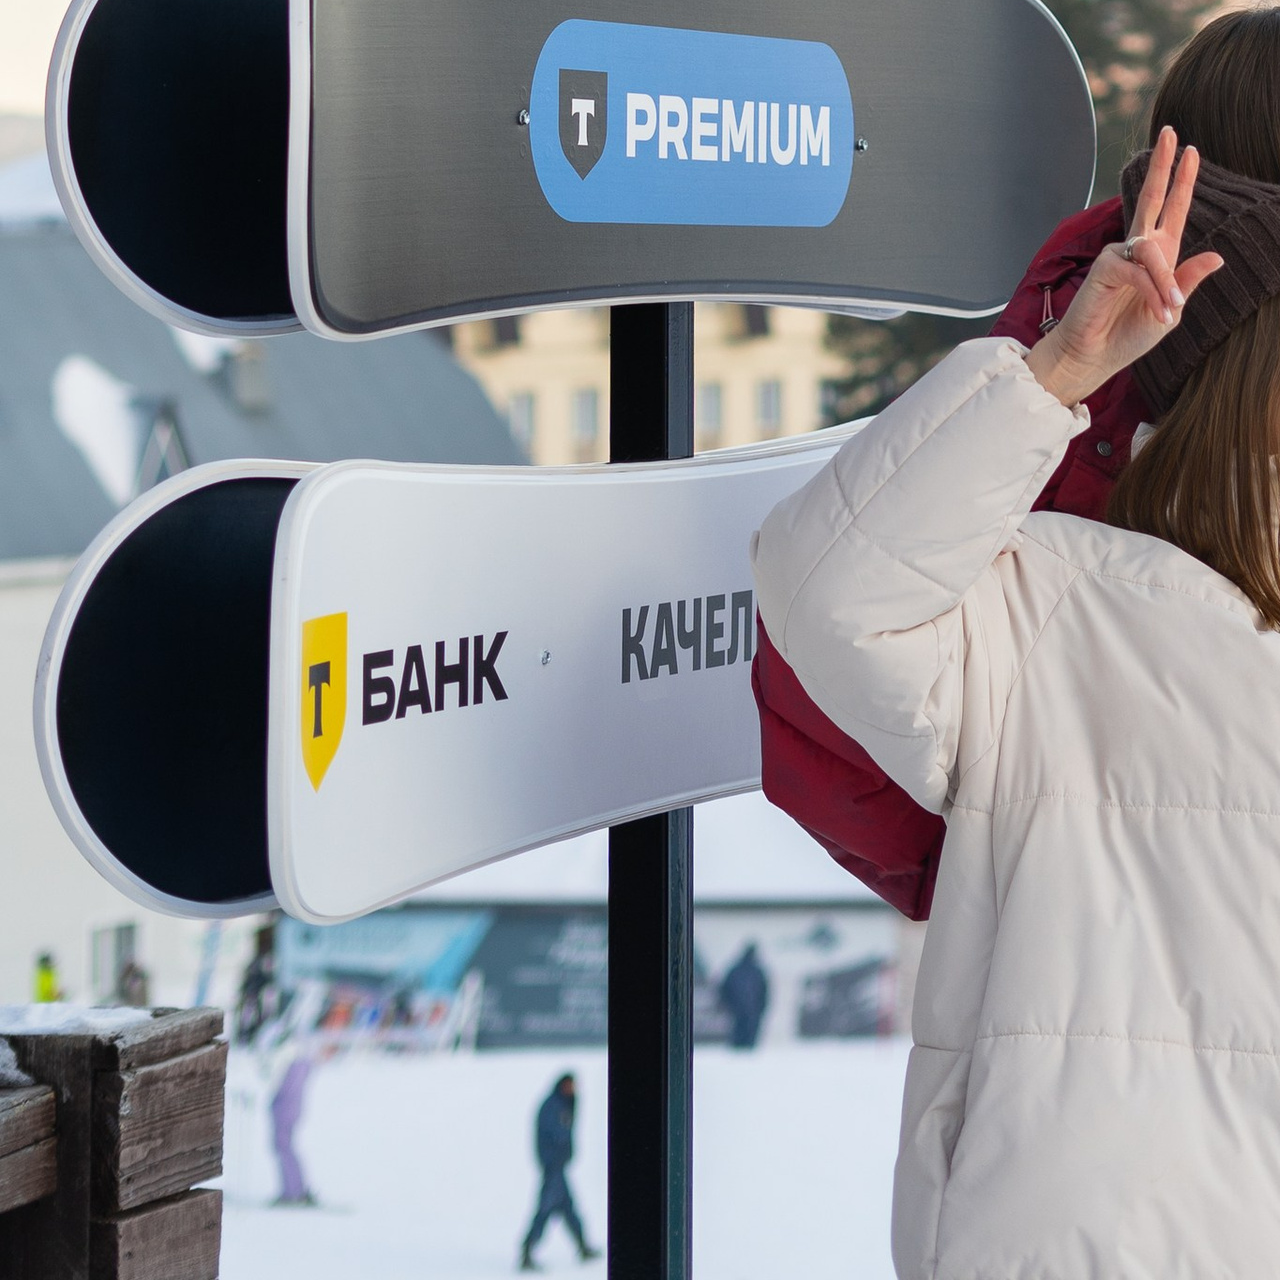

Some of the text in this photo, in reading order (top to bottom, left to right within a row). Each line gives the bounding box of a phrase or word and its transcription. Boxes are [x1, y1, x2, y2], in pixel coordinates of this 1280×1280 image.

[626, 92, 830, 167] PREMIUM
[362, 630, 509, 726] БАНК
[621, 589, 753, 684] КАЧЕЛ
